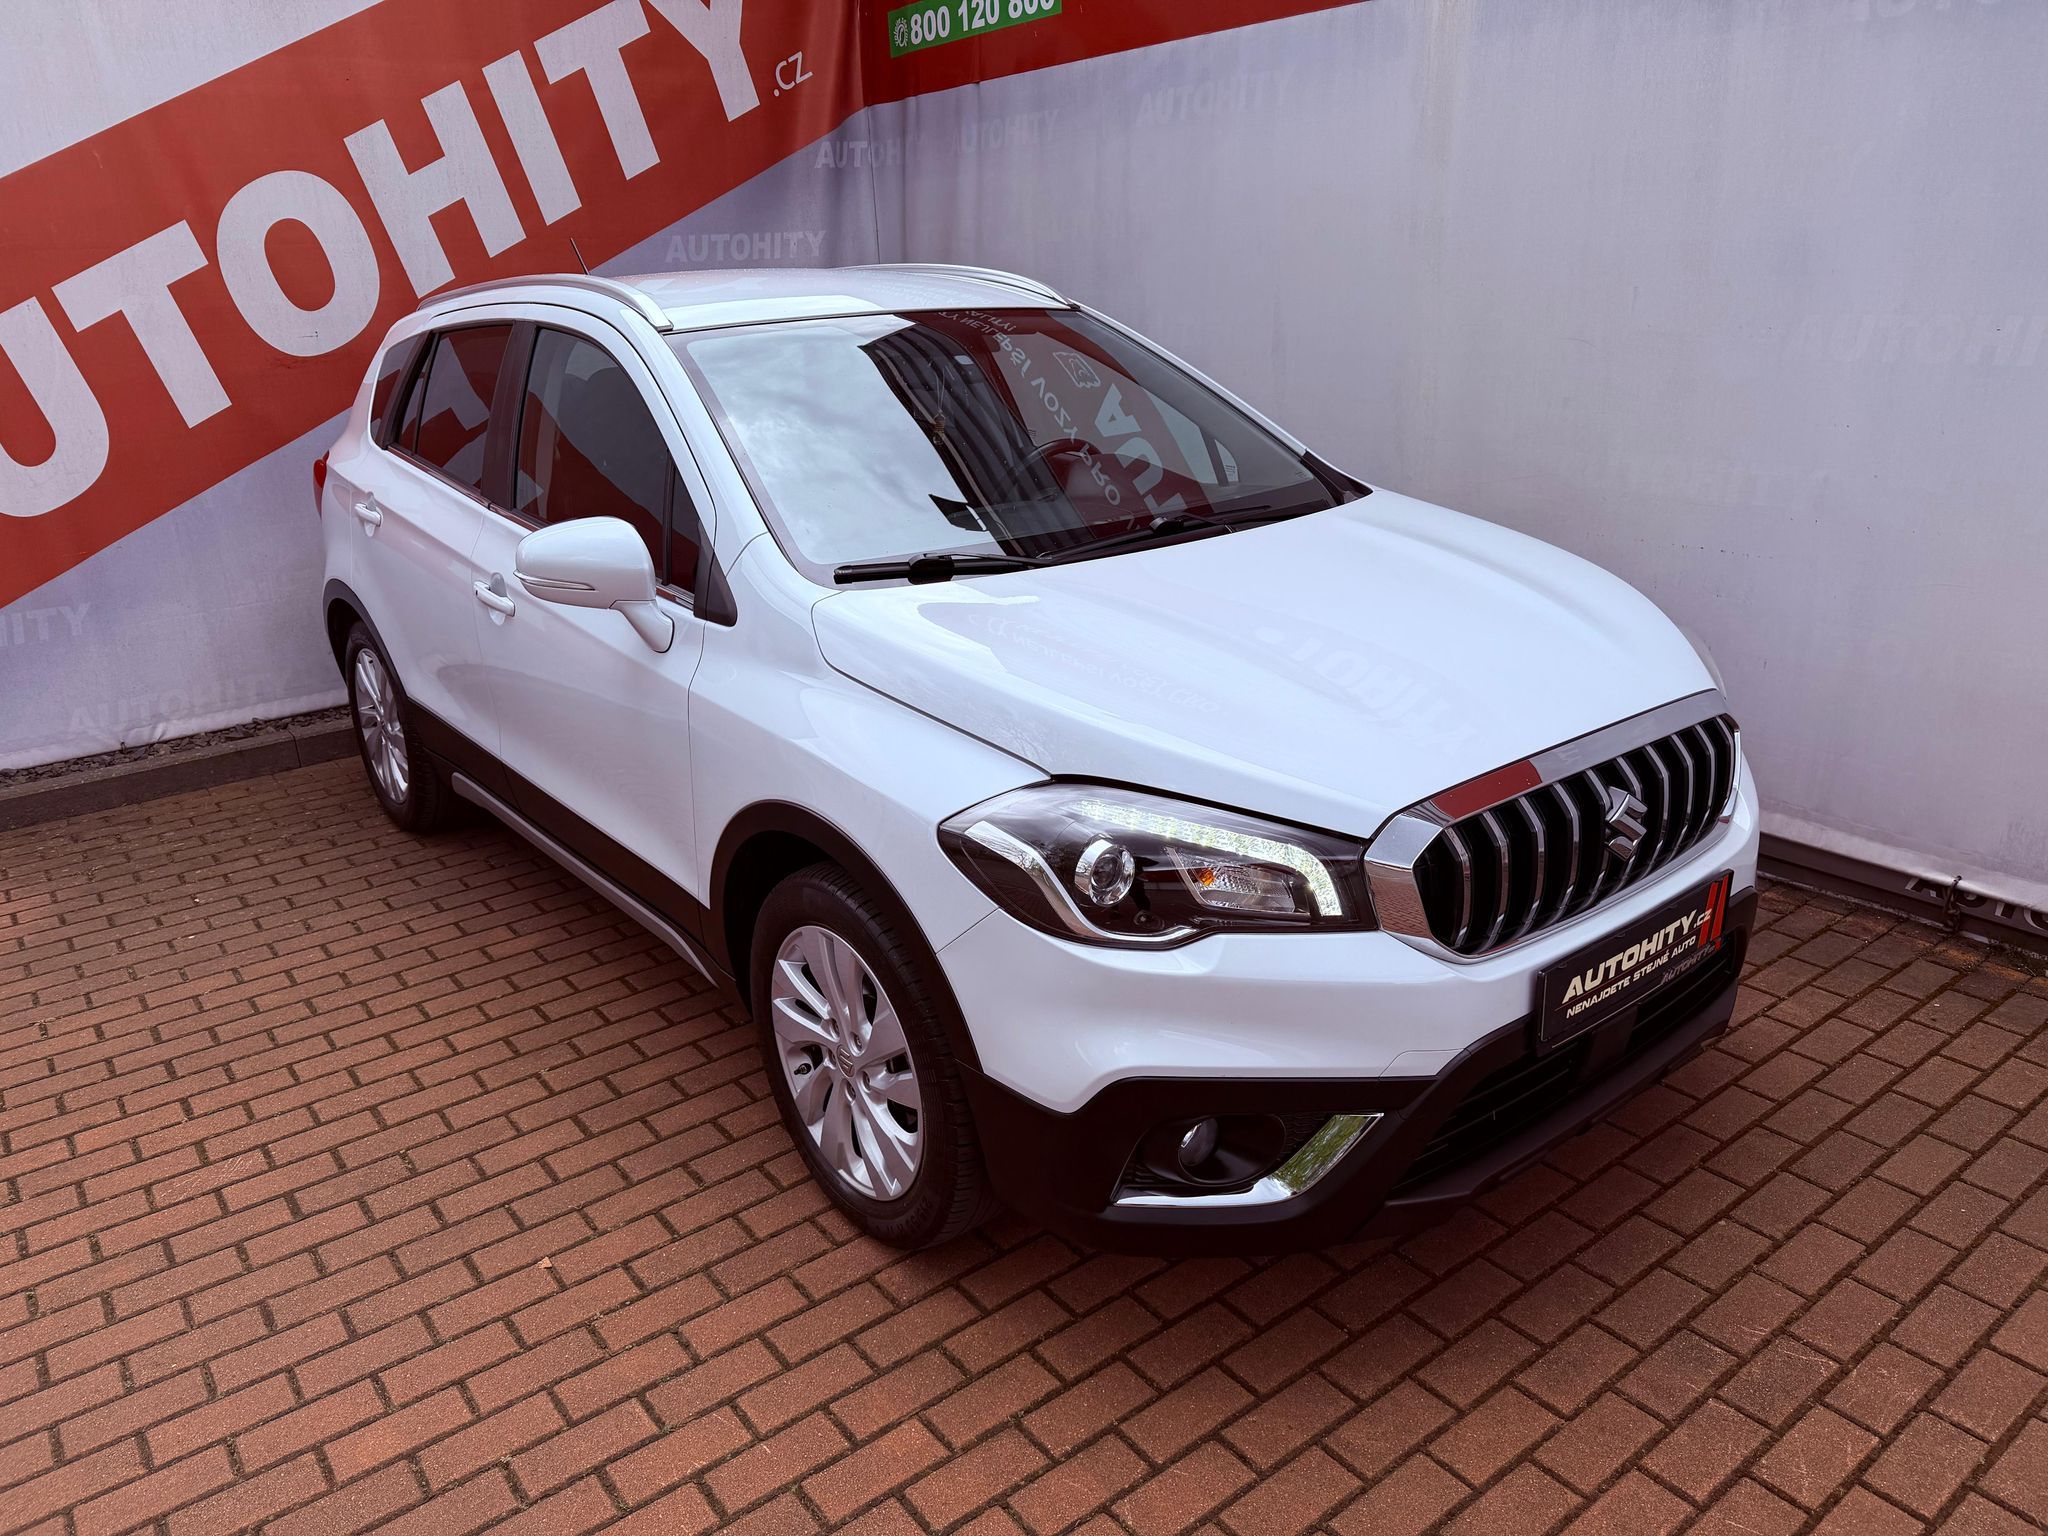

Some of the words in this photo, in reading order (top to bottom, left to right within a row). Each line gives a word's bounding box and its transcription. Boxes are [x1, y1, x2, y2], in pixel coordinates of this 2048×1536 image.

[911, 5, 950, 45] 800
[958, 0, 1000, 31] 120
[664, 230, 827, 263] AUTOHITY
[1566, 980, 1631, 1019] NENAJDETE
[1633, 950, 1670, 983] STEJNÉ
[1671, 935, 1697, 959] AUTO
